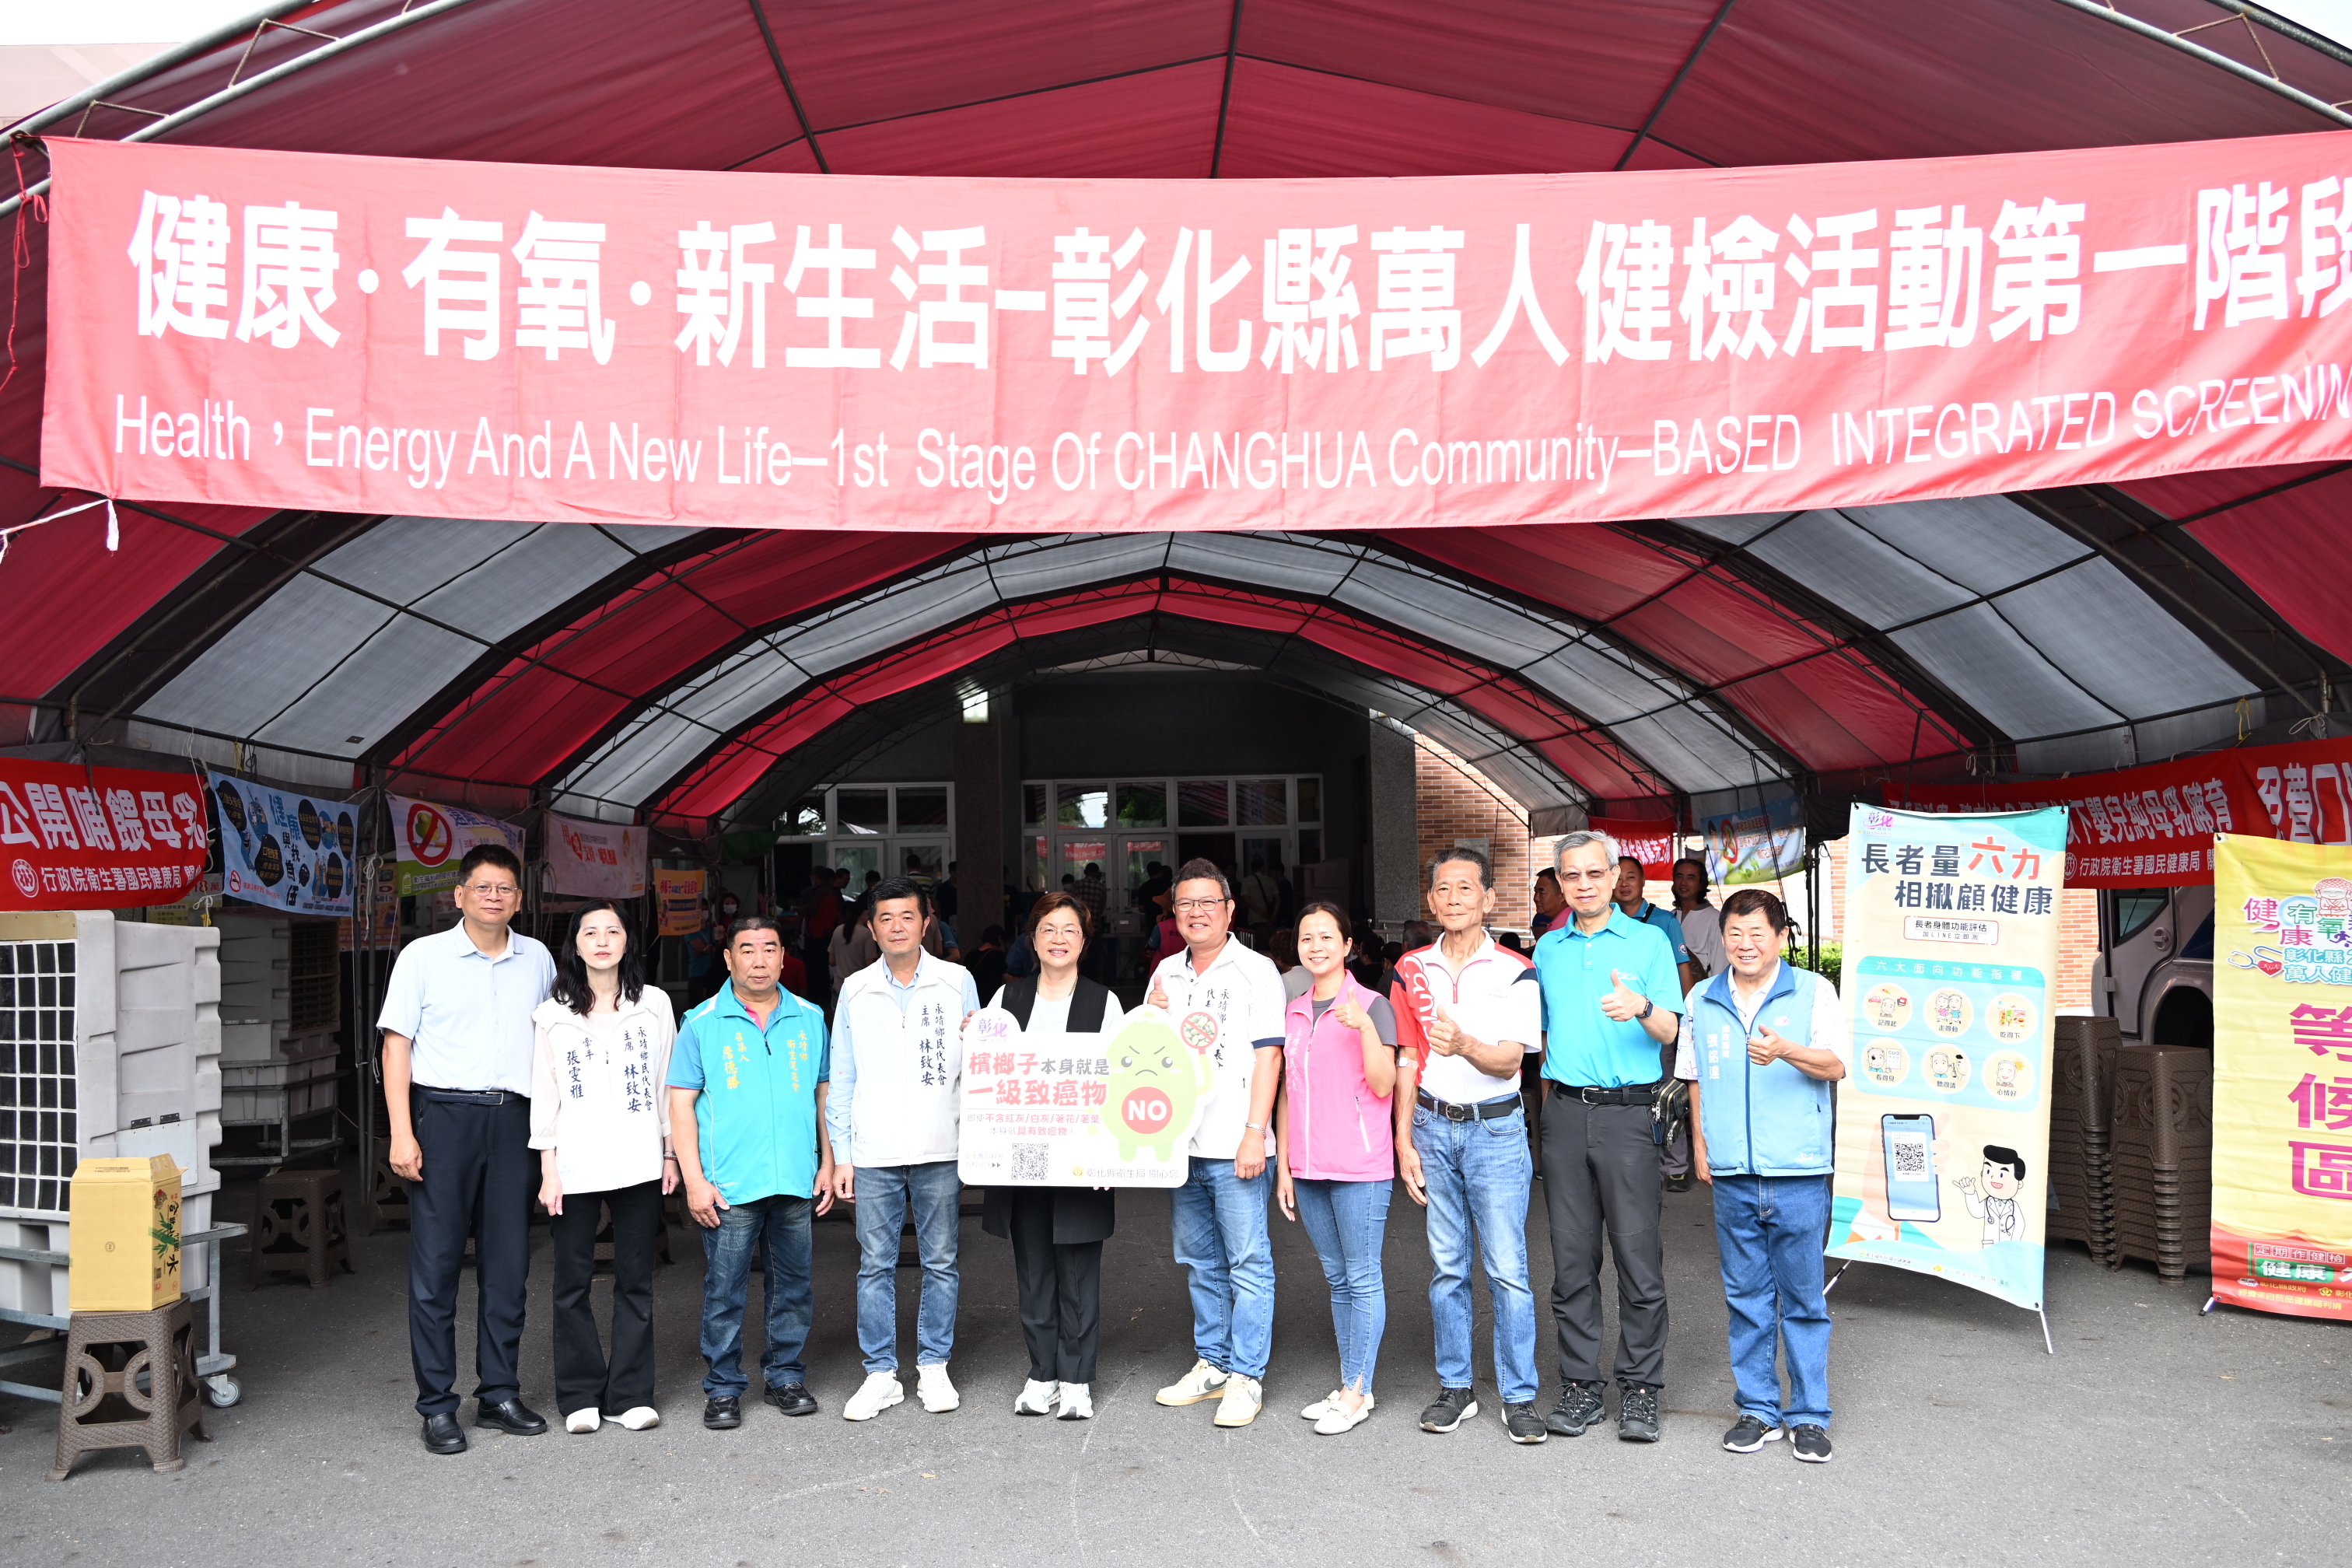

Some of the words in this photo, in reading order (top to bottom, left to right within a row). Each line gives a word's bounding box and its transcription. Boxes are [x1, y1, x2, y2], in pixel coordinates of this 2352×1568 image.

[306, 407, 457, 490] Energy
[467, 416, 552, 480] And
[563, 421, 596, 481] A
[609, 422, 702, 485] New
[915, 427, 1036, 505] Stage
[1051, 431, 1101, 492] Of
[1113, 429, 1377, 492] CHANGHUA
[1831, 390, 2116, 467] INTEGRATED
[0, 781, 207, 852] 公開哺餵母乳
[1861, 835, 2040, 880] 長者量六力
[2079, 849, 2200, 877] 行政院衛生署國民健康局
[40, 865, 182, 894] 行政院衛生署國民健康局
[1894, 880, 2053, 915] 相揪顧健康
[1915, 919, 1987, 933] 長者身體功能評估
[1875, 960, 2023, 982] 六大面向功能指標
[920, 1005, 930, 1027] 主席
[1878, 1019, 1897, 1027] 記得起
[1938, 1024, 1958, 1033] 走得動
[625, 1030, 634, 1052] 主席
[734, 1031, 751, 1062] 召集人
[935, 1003, 947, 1086] 永靖鄉民代表會
[637, 1026, 653, 1111] 永靖鄉民代表會
[723, 1045, 741, 1090] 詹德勝
[919, 1038, 935, 1087] 林致安
[968, 1051, 1110, 1076] 檳榔子本身就是
[1706, 1033, 1720, 1080] 張銘達
[566, 1049, 584, 1099] 張雯雅
[1875, 1073, 1895, 1083] 看得見
[1936, 1080, 1956, 1089] 聽得清
[624, 1064, 642, 1114] 林致安
[967, 1079, 1108, 1107] 一級致癌物
[1997, 1089, 2018, 1097] 心情好
[1127, 1100, 1168, 1122] NO
[1087, 1168, 1146, 1178] 彰化縣衛生局
[1149, 1168, 1179, 1179] 關心您
[2256, 1244, 2344, 1264] 定期作健檢
[2260, 1260, 2326, 1281] 健康
[2238, 1288, 2342, 1311] 經費來自菸品健康福利捐
